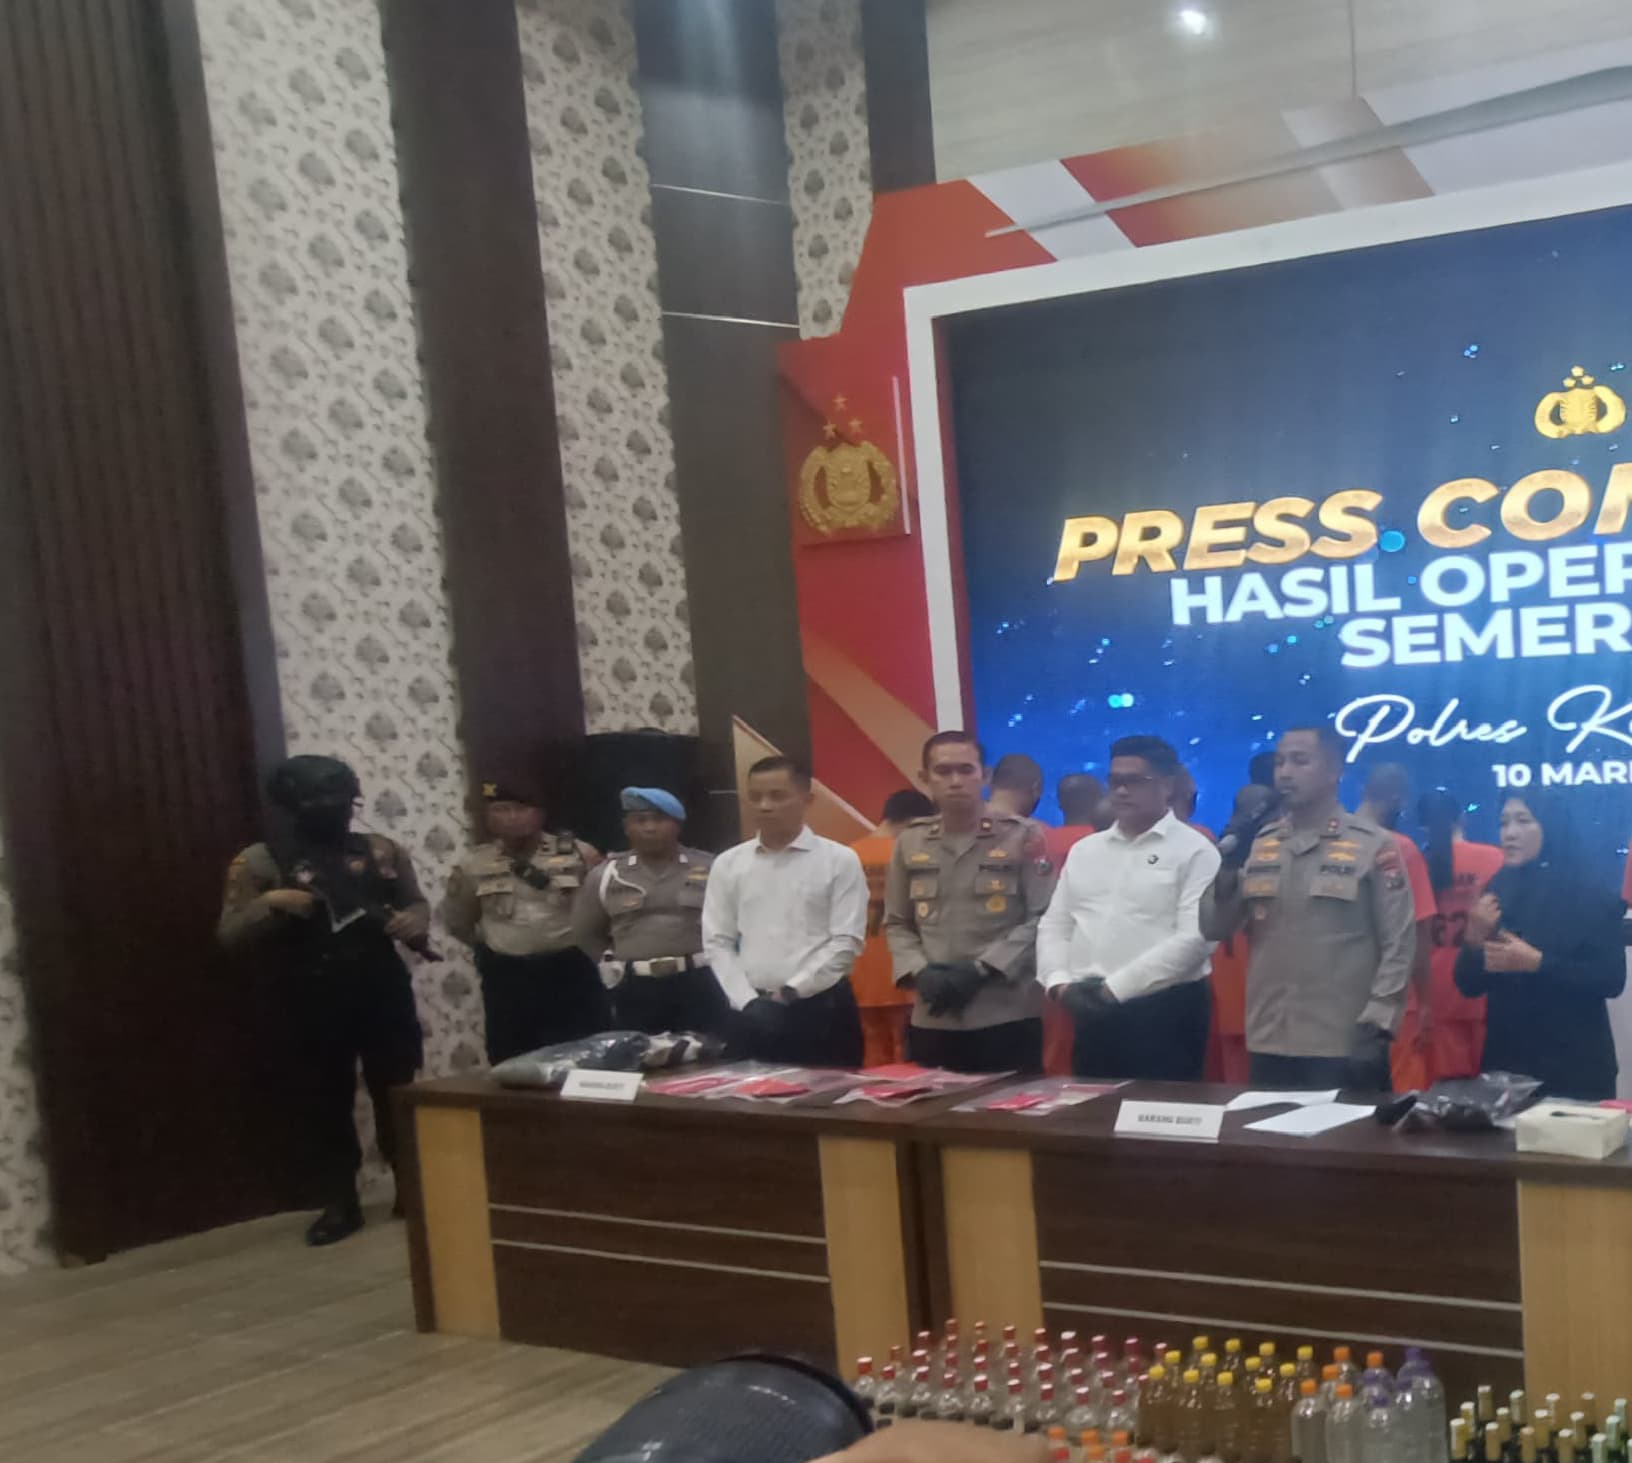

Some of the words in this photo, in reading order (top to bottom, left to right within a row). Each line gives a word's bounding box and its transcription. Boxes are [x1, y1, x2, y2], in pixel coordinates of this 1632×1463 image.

[1052, 490, 1383, 582] PRESS
[1170, 563, 1401, 626] HASIL
[1335, 694, 1528, 763] Polres
[1492, 762, 1532, 787] 10
